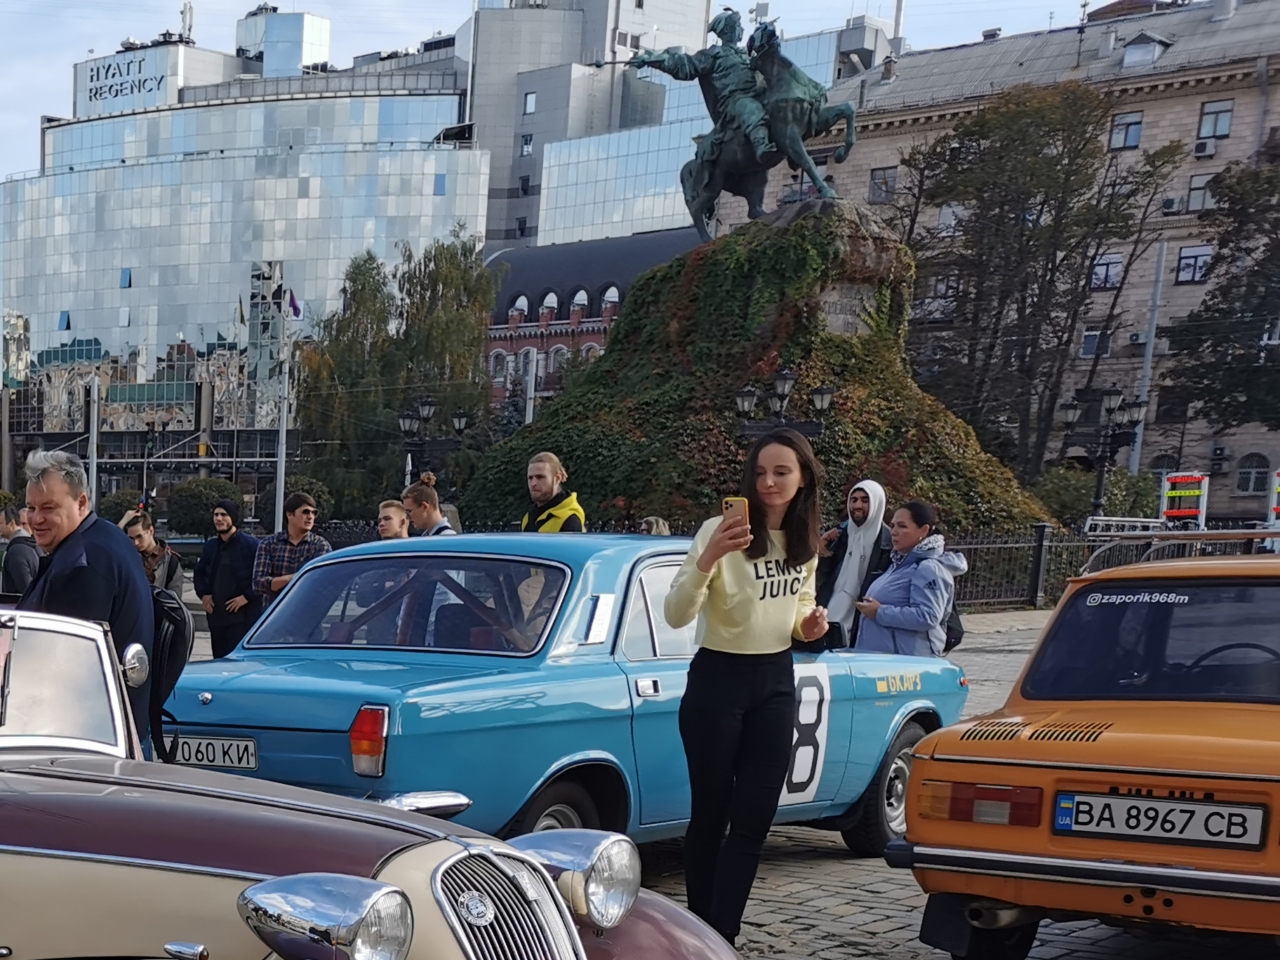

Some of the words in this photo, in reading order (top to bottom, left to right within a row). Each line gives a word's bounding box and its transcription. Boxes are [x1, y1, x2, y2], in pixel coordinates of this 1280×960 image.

[89, 58, 145, 83] HYATT
[88, 75, 165, 102] REGENCY
[753, 559, 806, 580] LEMO
[759, 577, 805, 601] JUIC
[174, 741, 216, 764] 060
[222, 743, 250, 765] КИ
[1058, 816, 1071, 825] UA
[1074, 801, 1116, 828] BA
[1125, 805, 1196, 834] 8967
[1204, 811, 1248, 839] CB
